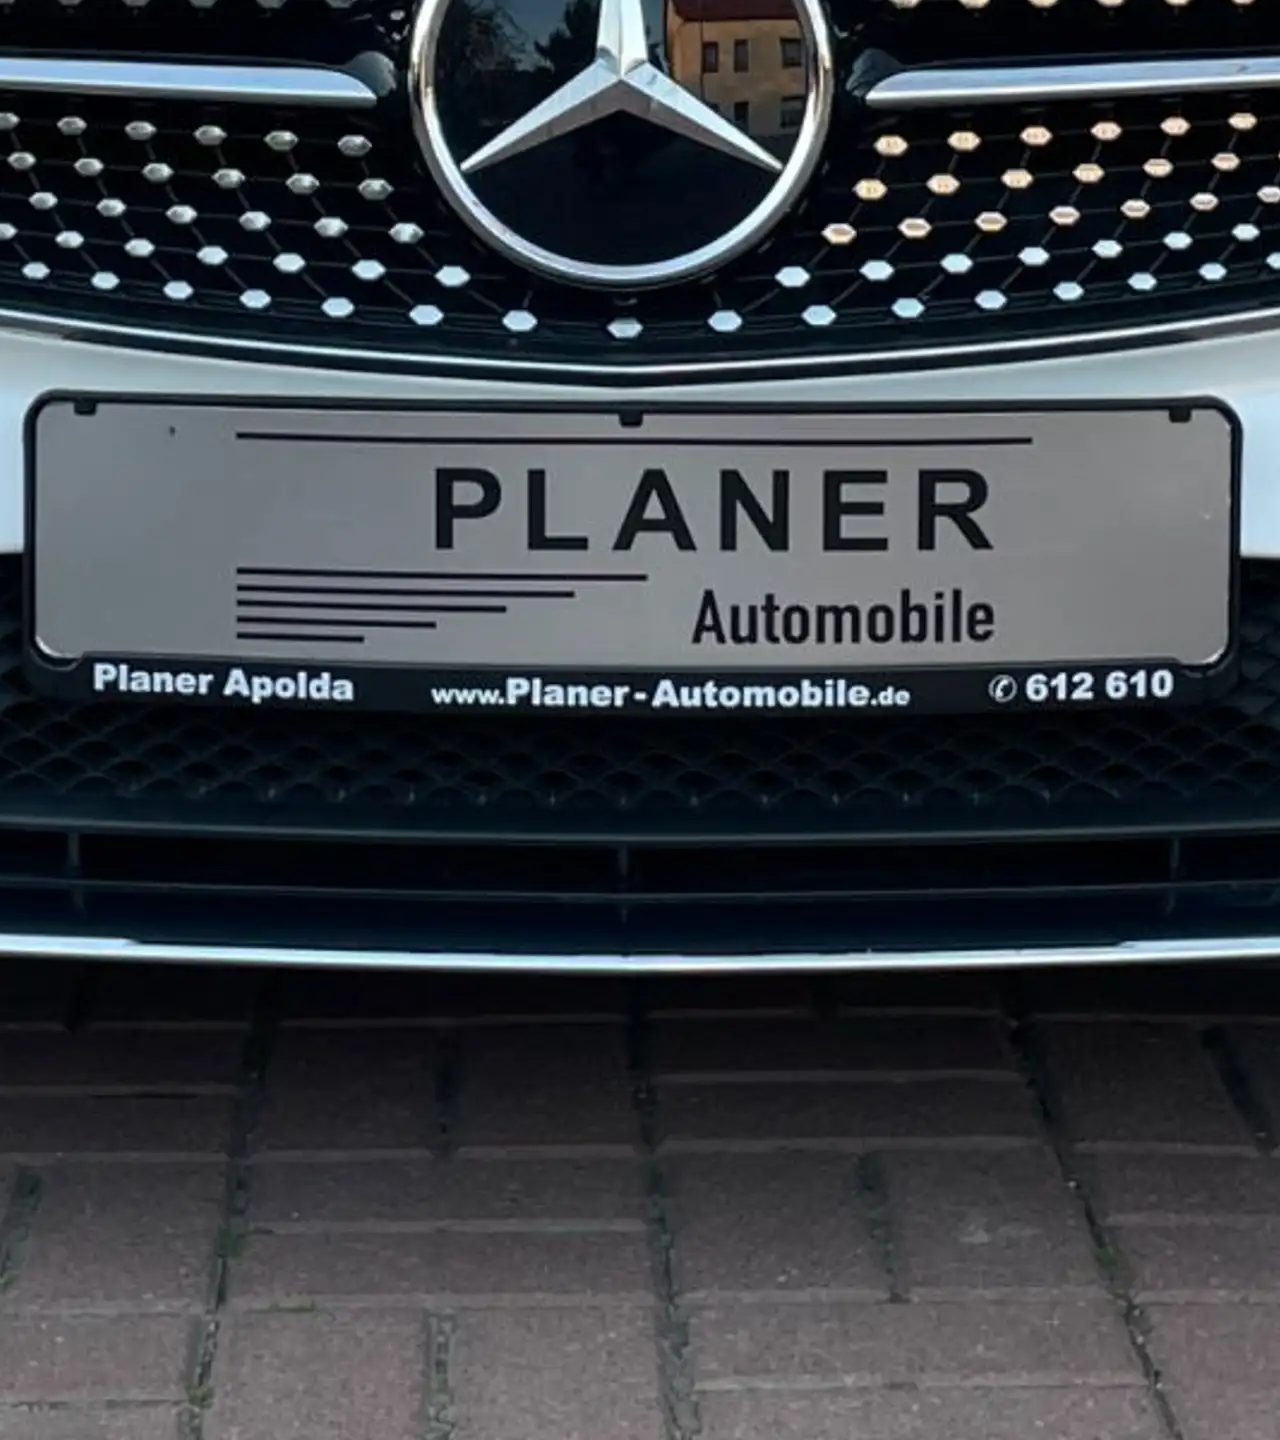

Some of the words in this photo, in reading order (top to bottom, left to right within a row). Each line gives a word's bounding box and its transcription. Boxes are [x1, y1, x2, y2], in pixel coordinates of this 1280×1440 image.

[434, 467, 994, 552] PLANER
[692, 588, 996, 644] Automobile
[93, 663, 214, 695] Planer
[223, 668, 355, 704] Apolda
[1025, 671, 1095, 702] 612
[1105, 669, 1175, 700] 610
